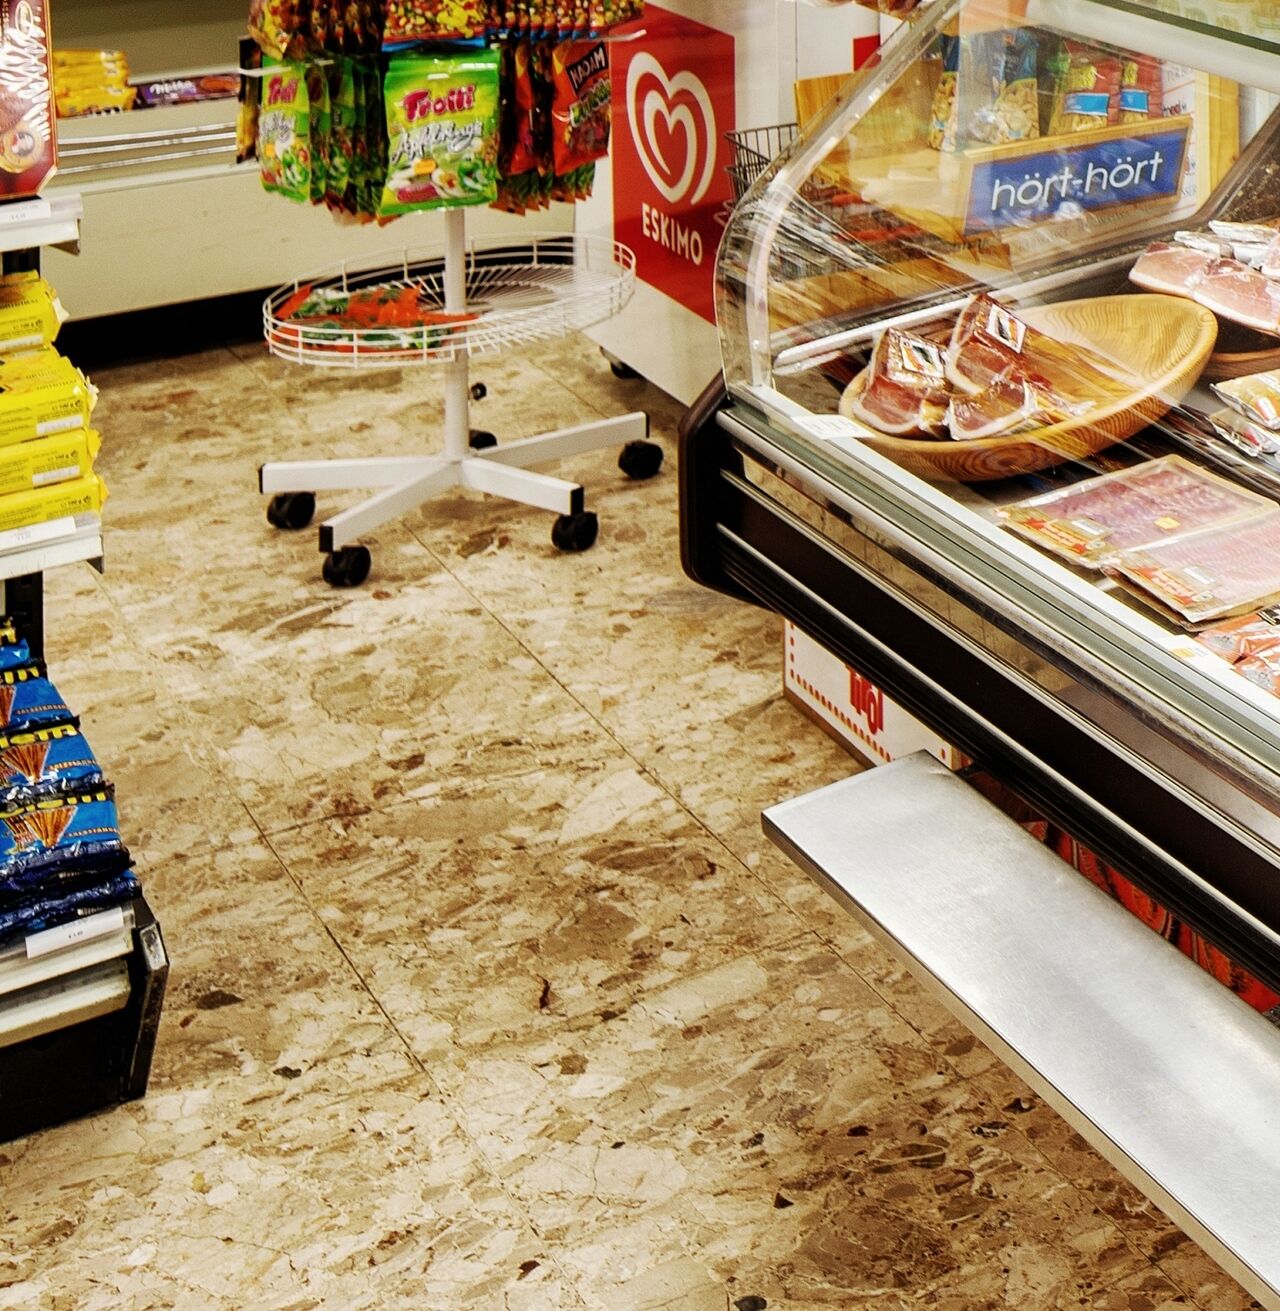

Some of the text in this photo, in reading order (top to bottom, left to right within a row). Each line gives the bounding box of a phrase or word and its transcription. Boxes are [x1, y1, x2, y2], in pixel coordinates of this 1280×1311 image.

[403, 84, 476, 122] Trolli
[990, 150, 1164, 211] hört-hört
[642, 202, 703, 267] ESKIMO
